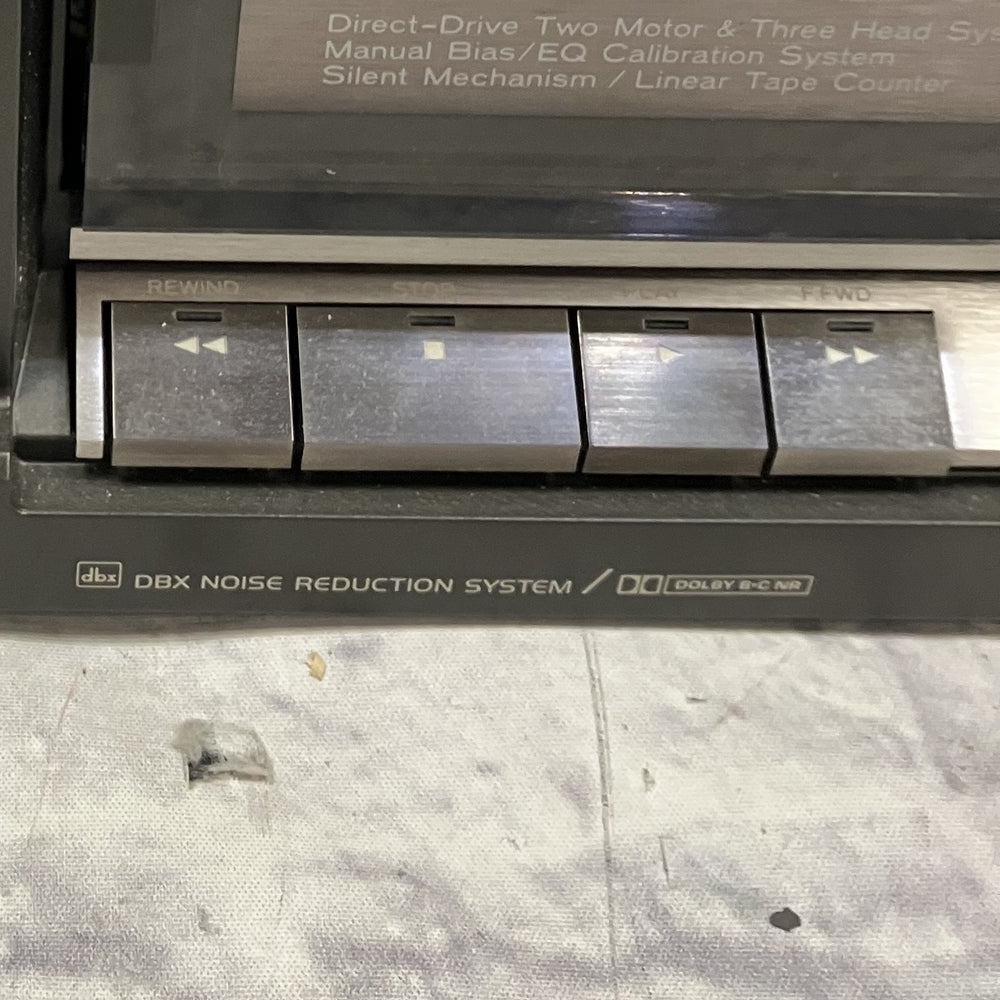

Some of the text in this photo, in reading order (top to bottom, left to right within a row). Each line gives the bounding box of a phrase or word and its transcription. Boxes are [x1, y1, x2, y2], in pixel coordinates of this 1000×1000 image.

[327, 13, 519, 36] Direct-Drive
[534, 16, 599, 37] Two
[613, 17, 704, 39] Motor
[716, 19, 737, 38] &
[751, 18, 836, 41] Three
[851, 20, 933, 42] Head
[324, 40, 896, 71] Manual Bias/EQ Calibration System
[322, 65, 409, 86] Silent
[423, 67, 597, 89] Mechanism
[635, 70, 730, 91] Linear
[746, 71, 818, 95] Tape
[833, 72, 951, 94] Counter
[147, 279, 241, 296] REWIND
[80, 566, 118, 583] dbx
[134, 574, 191, 590] DBX
[200, 575, 284, 592] NOISE
[295, 576, 454, 593] REDUCTION
[464, 578, 573, 595] SYSTEM
[674, 580, 736, 591] DOLBY
